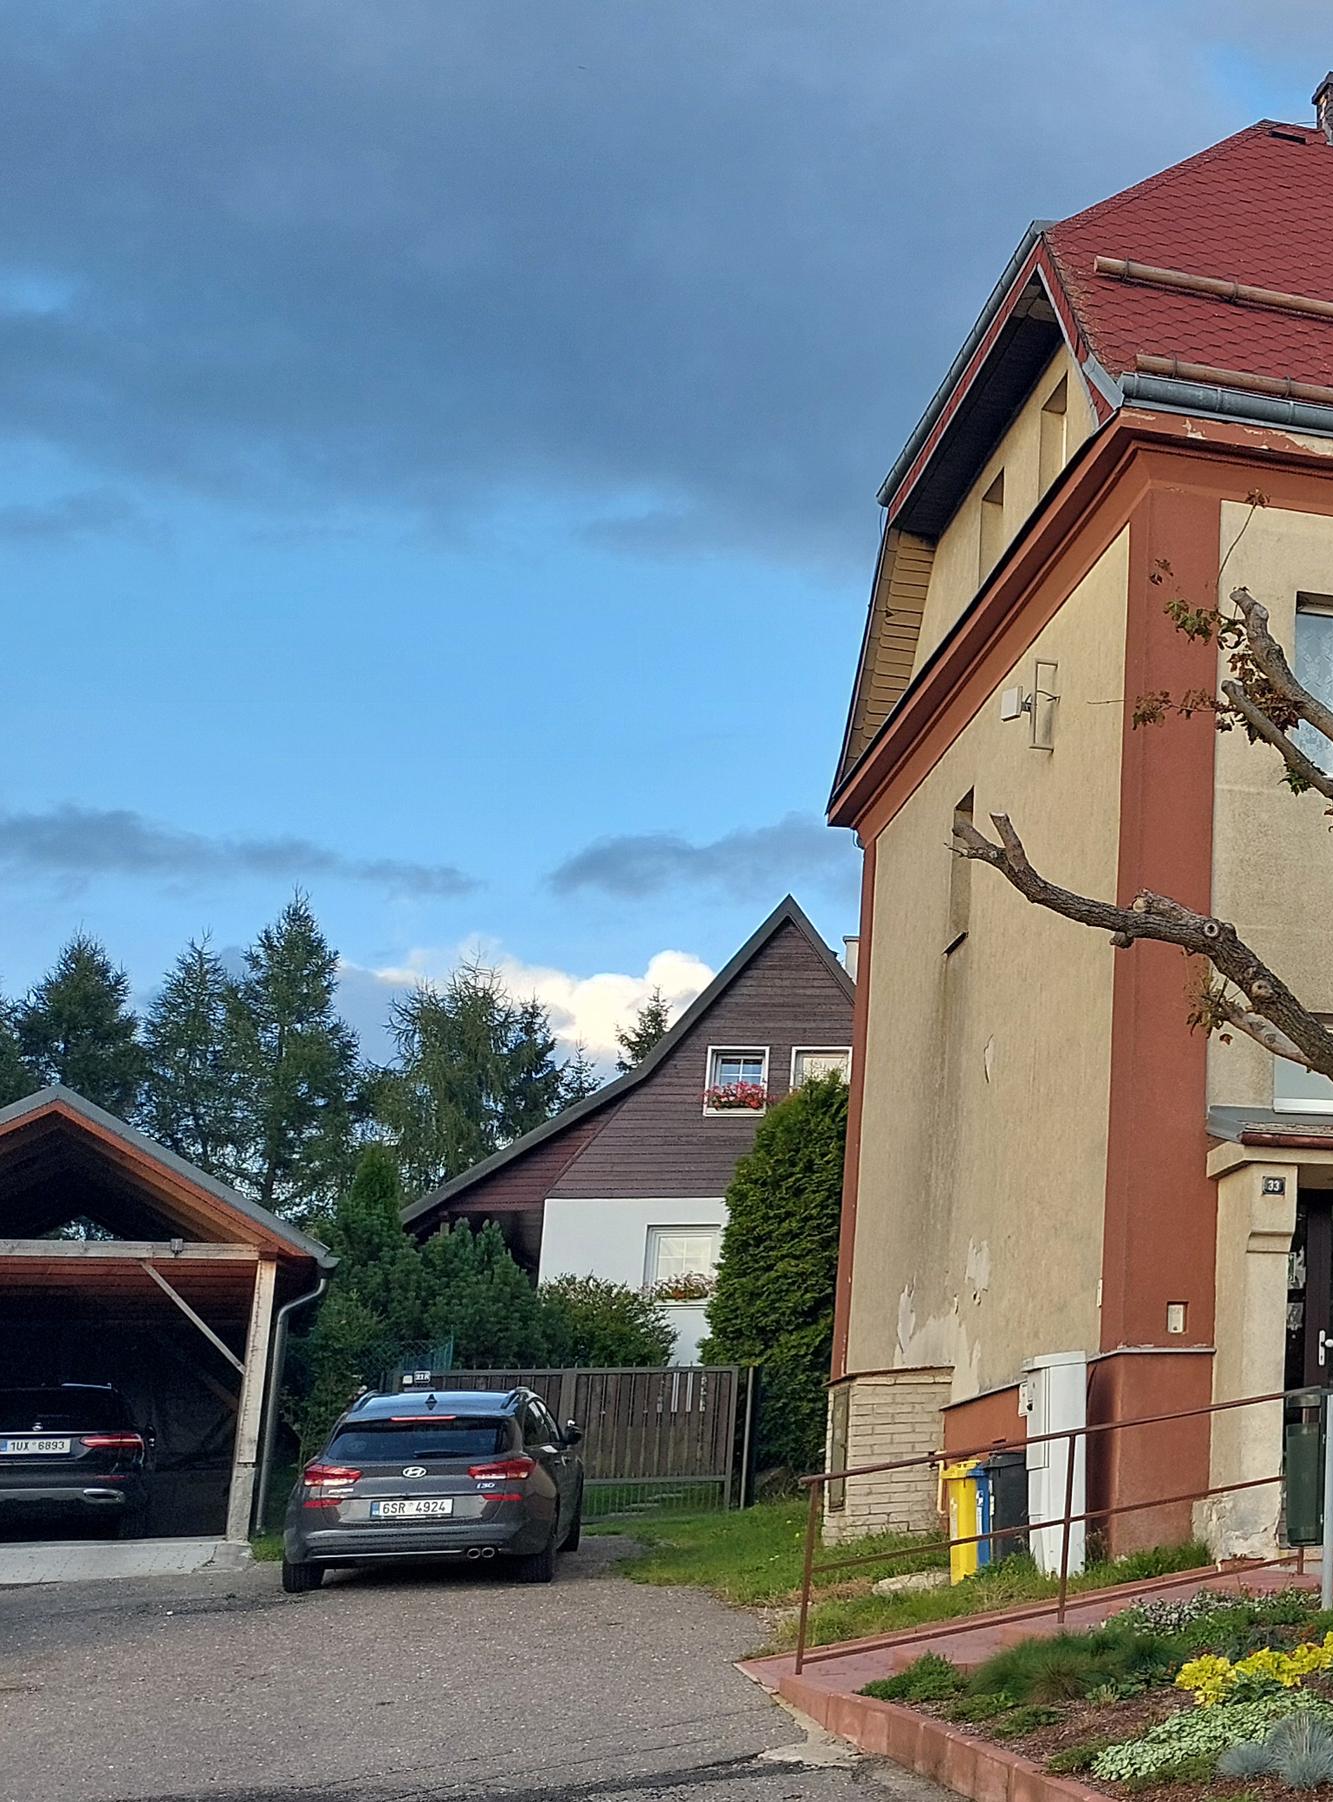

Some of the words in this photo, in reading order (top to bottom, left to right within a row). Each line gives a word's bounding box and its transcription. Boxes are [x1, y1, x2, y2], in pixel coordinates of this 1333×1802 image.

[1267, 1180, 1280, 1191] 33
[10, 1441, 30, 1451] 1UX
[382, 1502, 406, 1514] 6SR
[415, 1501, 446, 1513] 4924
